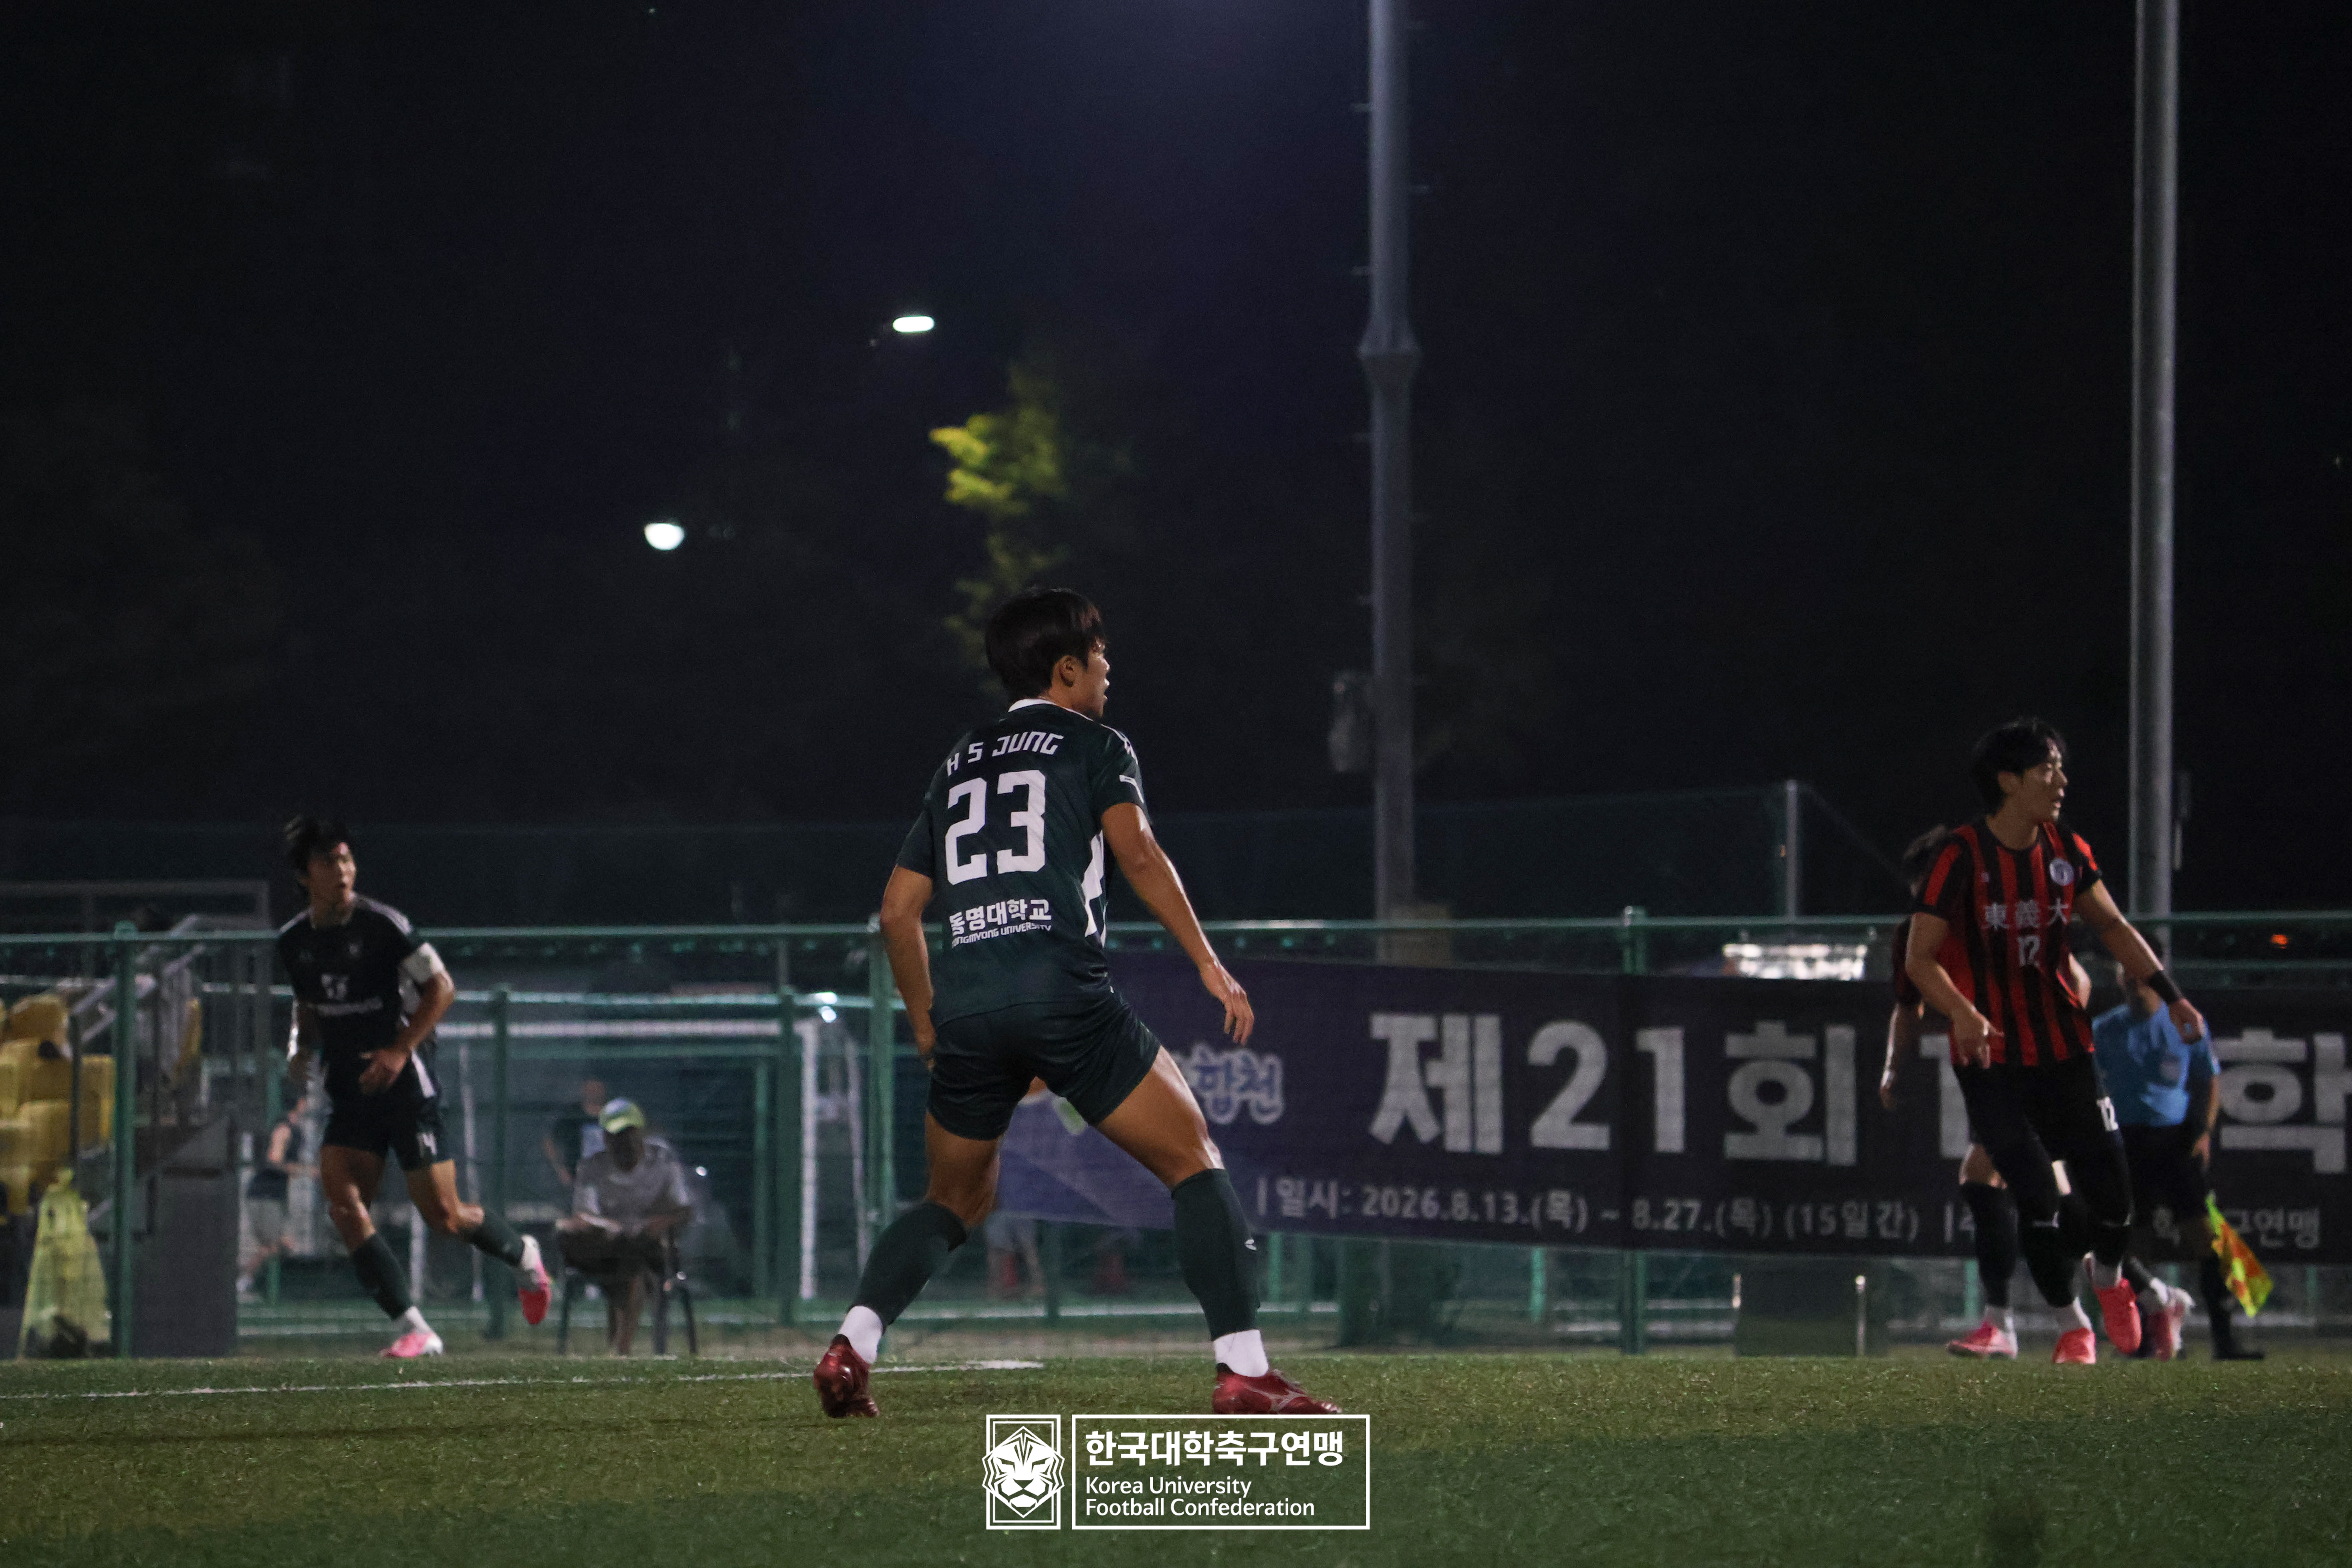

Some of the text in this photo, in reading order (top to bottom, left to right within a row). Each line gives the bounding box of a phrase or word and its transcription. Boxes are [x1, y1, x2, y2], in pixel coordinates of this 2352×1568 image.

[947, 731, 1064, 777] H S JUNG
[945, 770, 1046, 886] 23
[949, 899, 1052, 937] 동명대학교
[1982, 898, 2071, 931] 東義大
[2017, 934, 2041, 967] 12
[1368, 1012, 1857, 1167] 제21회
[1276, 1177, 1351, 1219] 일시:
[1784, 1201, 1921, 1243] (15일간)
